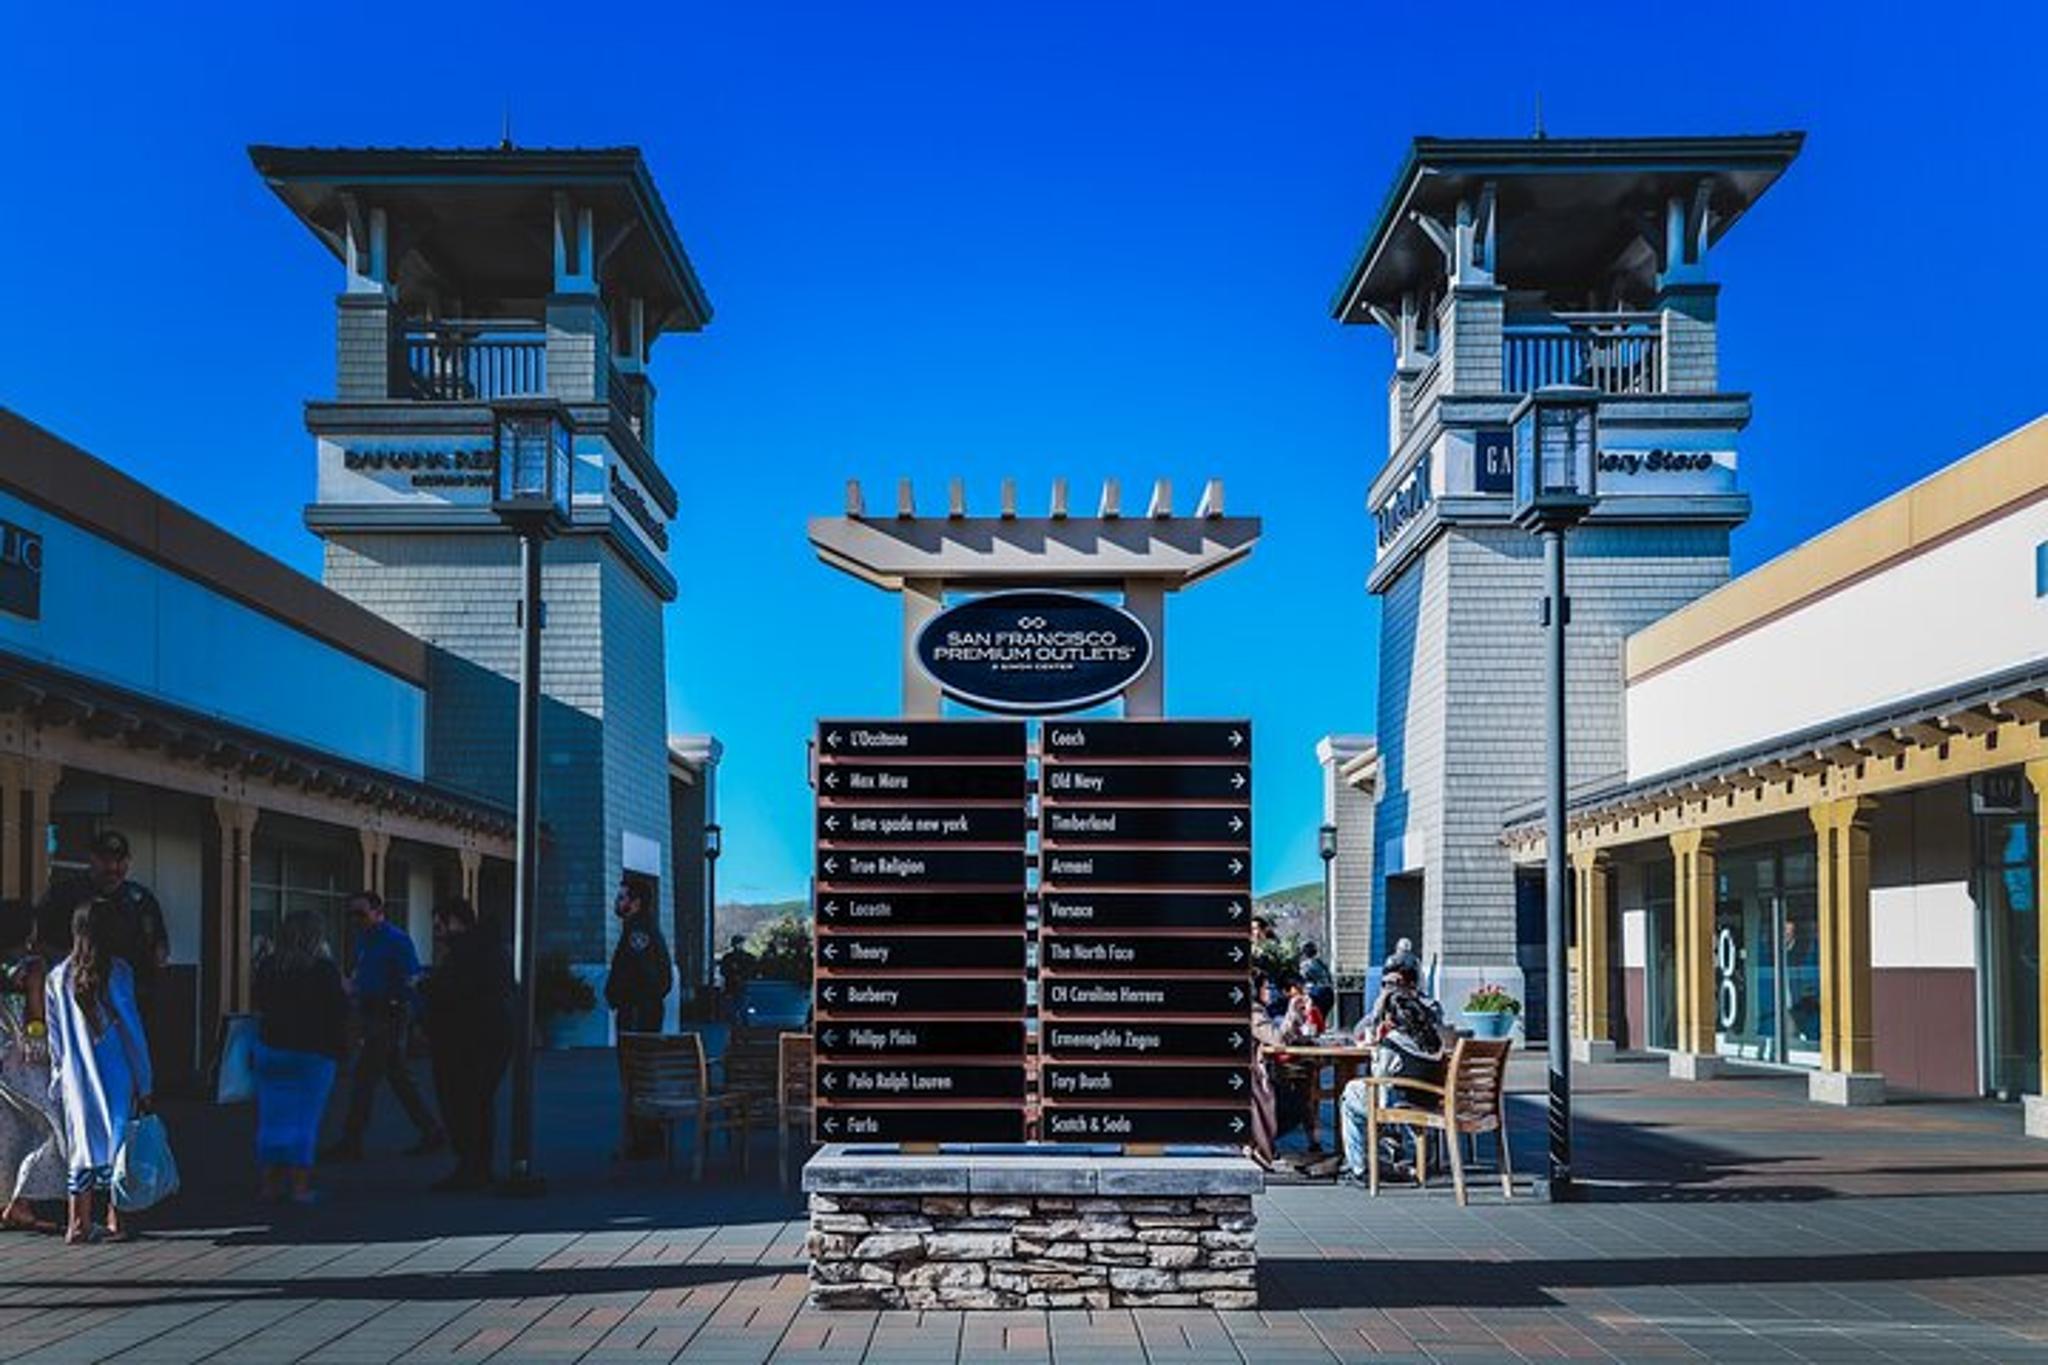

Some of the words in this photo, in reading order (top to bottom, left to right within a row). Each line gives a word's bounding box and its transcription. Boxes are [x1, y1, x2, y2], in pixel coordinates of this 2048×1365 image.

[1645, 448, 1713, 474] Store
[947, 631, 991, 647] SAN
[995, 631, 1117, 647] FRANCISCO
[933, 646, 1031, 662] PREMIUM
[1035, 646, 1132, 662] OUTLETS
[850, 730, 908, 747] L'Occitane
[1051, 729, 1086, 746] Coach
[849, 772, 875, 789] Max
[878, 772, 909, 789] Mara
[1051, 772, 1071, 789] Old
[1074, 772, 1104, 792] Navy
[851, 814, 877, 831] kate
[879, 814, 914, 835] spade
[916, 818, 940, 832] new
[942, 814, 969, 835] york
[1051, 813, 1117, 831] Timberland
[849, 857, 876, 874] True
[878, 856, 926, 877] Religion
[1051, 858, 1094, 874] Armani
[850, 900, 892, 917] Lacoste
[1049, 902, 1094, 918] Versace
[849, 943, 890, 962] Theory
[1050, 944, 1072, 960] The
[1074, 944, 1107, 960] North
[1109, 944, 1135, 960] Face
[848, 986, 899, 1005] Burberry
[1051, 986, 1067, 1003] CH
[1069, 986, 1119, 1003] Carolina
[1120, 986, 1165, 1003] Herrera
[848, 1029, 887, 1049] Philipp
[1051, 1029, 1122, 1050] Ermenegildo
[1124, 1030, 1161, 1051] Zegna
[847, 1072, 874, 1089] Polo
[876, 1072, 910, 1092] Ralph
[913, 1073, 953, 1090] Lauren
[1051, 1072, 1077, 1092] Tory
[1079, 1072, 1112, 1089] Burch
[847, 1116, 879, 1133] Furla
[1051, 1115, 1087, 1133] Scotch
[1089, 1116, 1100, 1133] &
[1102, 1115, 1132, 1133] Soda
